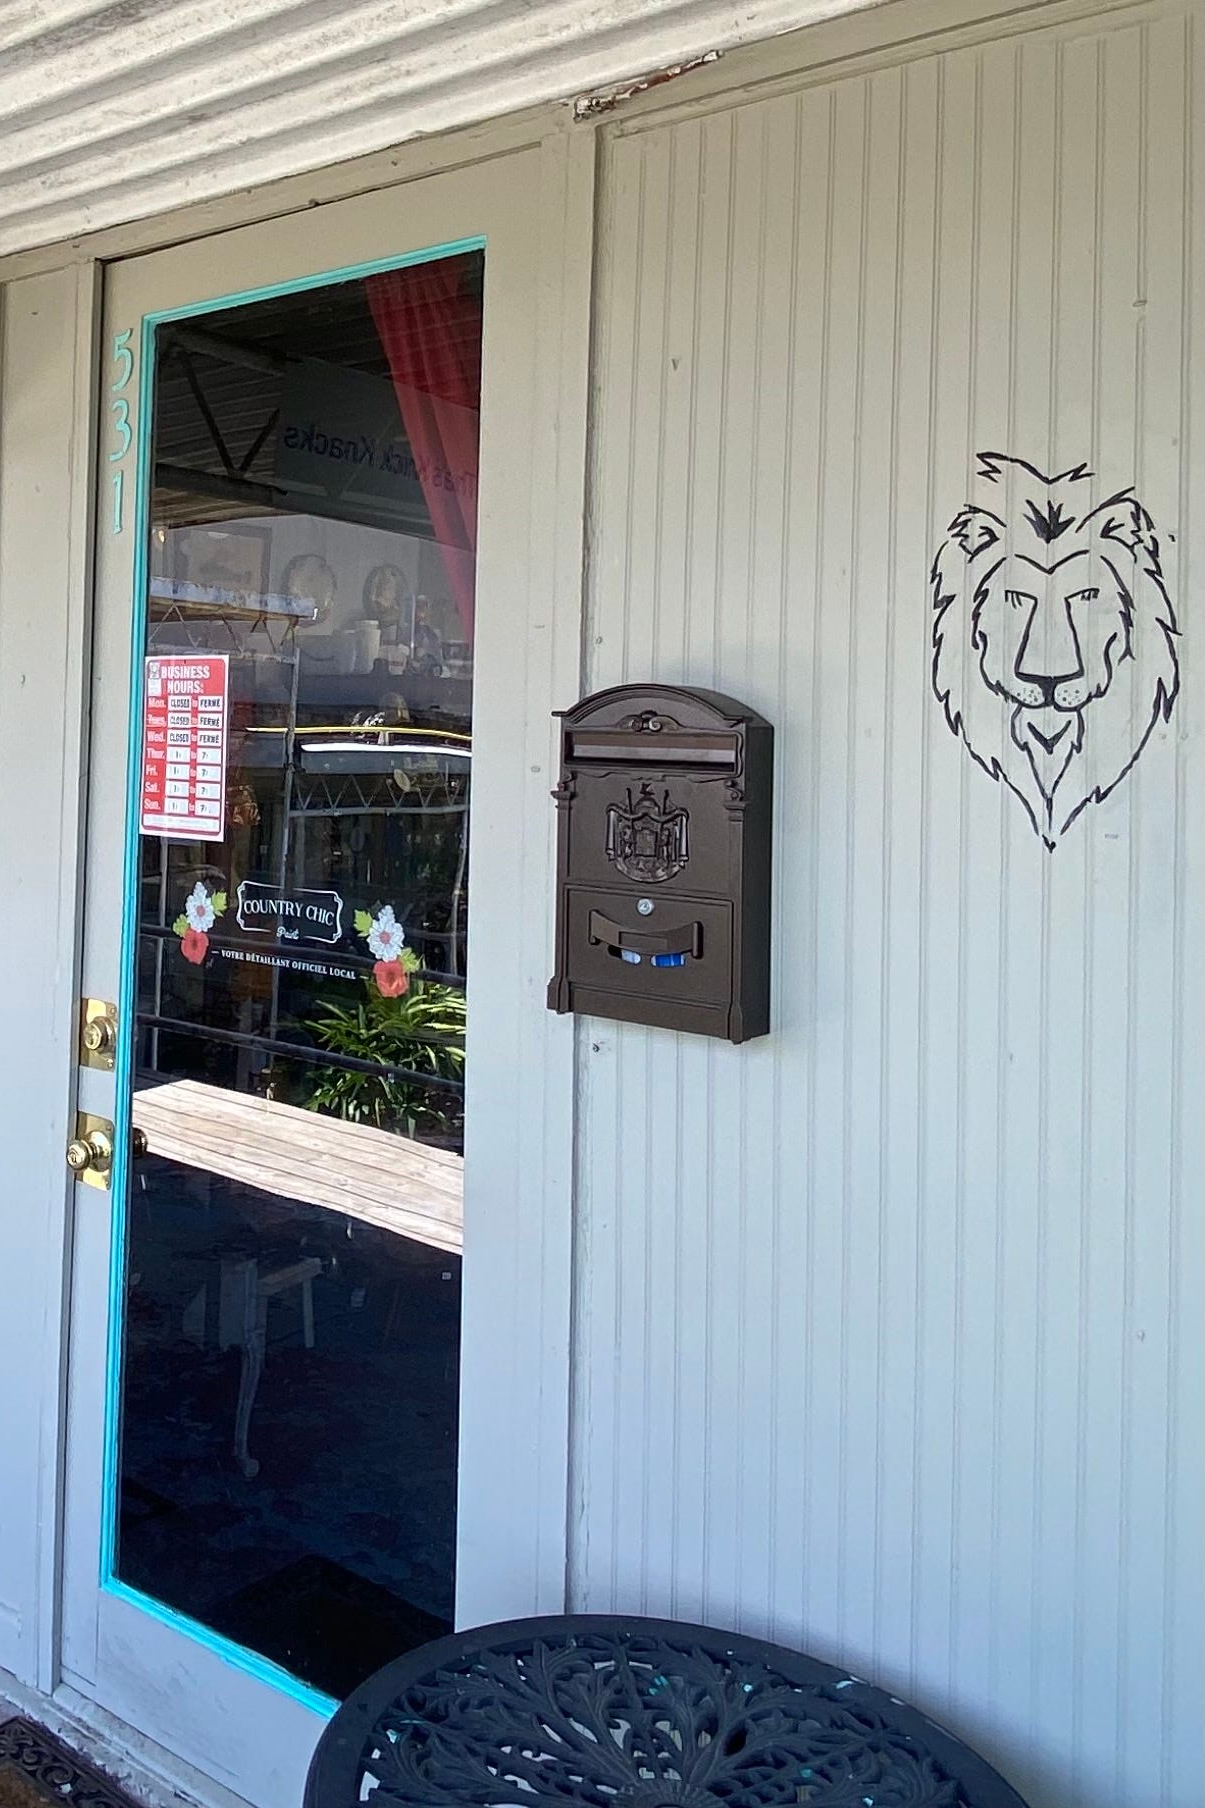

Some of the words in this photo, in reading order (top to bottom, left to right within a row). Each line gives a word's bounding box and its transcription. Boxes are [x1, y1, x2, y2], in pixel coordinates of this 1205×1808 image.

[109, 328, 135, 534] 531
[161, 665, 210, 679] BUSINESS
[167, 680, 204, 694] HOURS:
[244, 899, 303, 918] COUNTRY
[306, 905, 335, 926] CHIC
[276, 926, 299, 940] Paint
[221, 949, 244, 960] VOTRE
[246, 951, 290, 969] DÉTAILLANT
[292, 961, 327, 975] OFFICIEL
[329, 966, 356, 980] LOCAL
